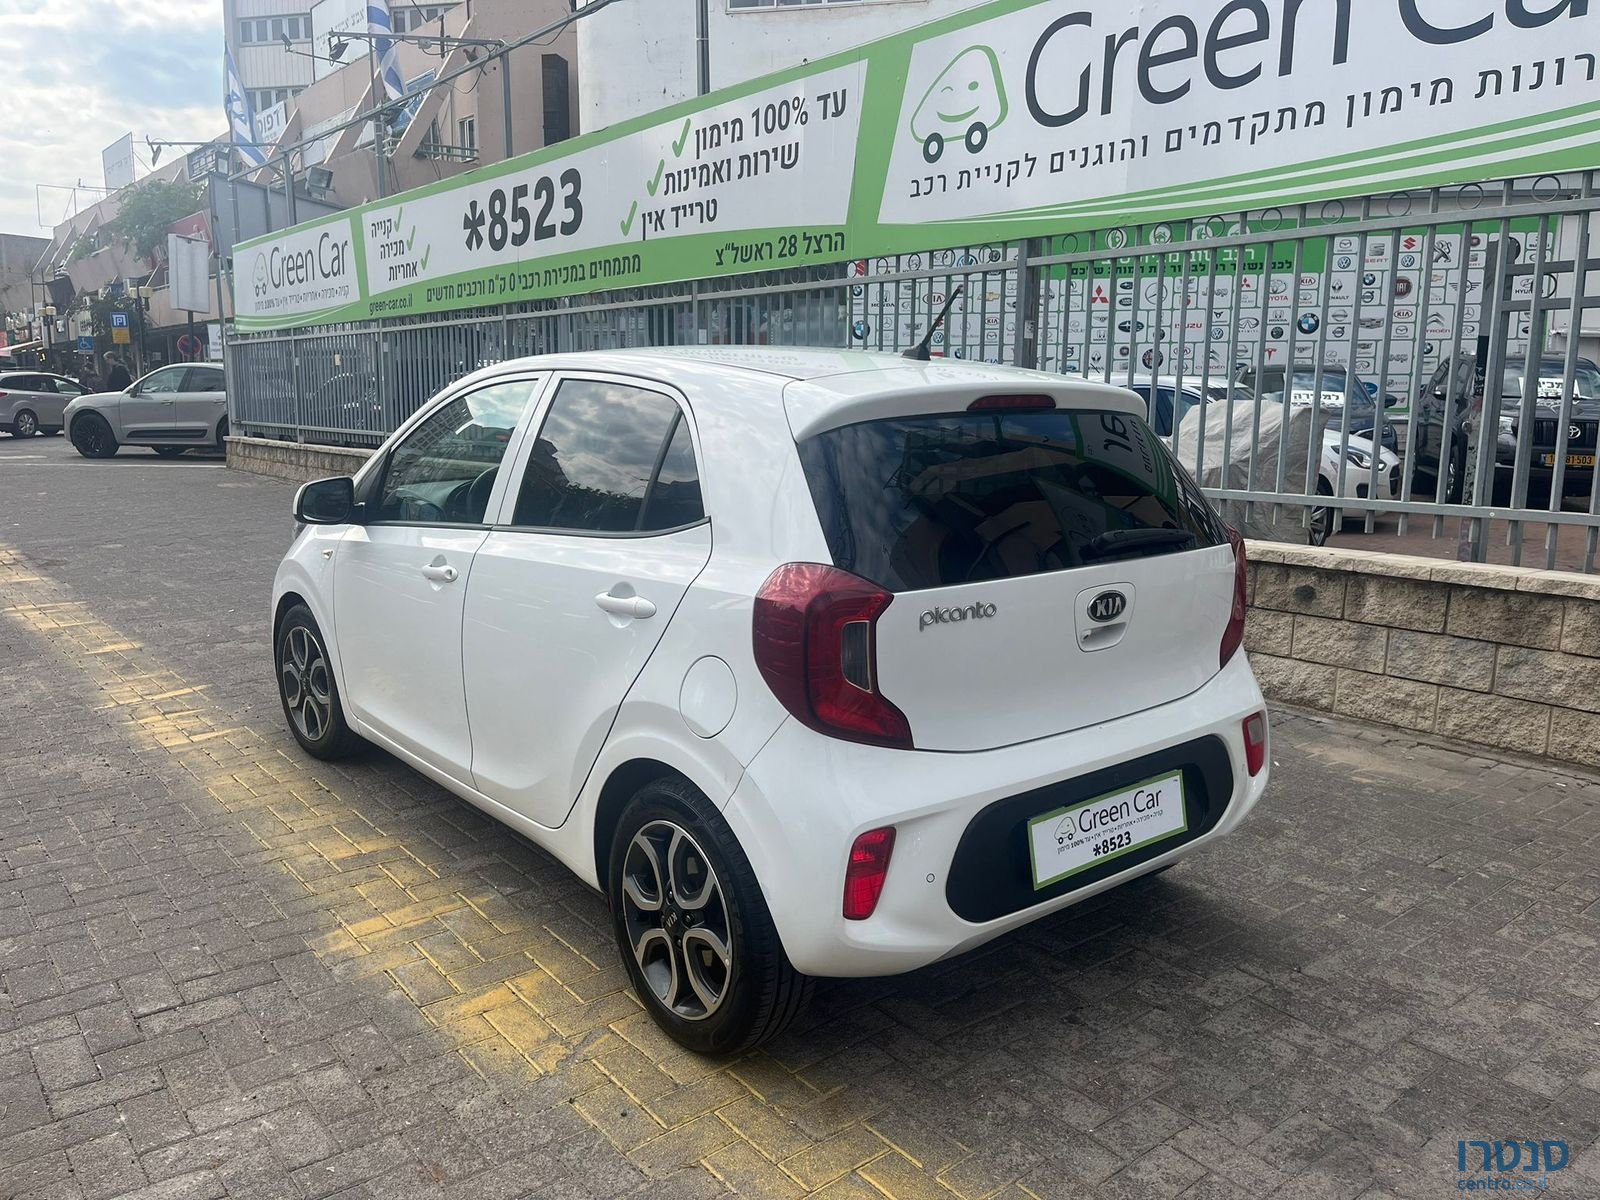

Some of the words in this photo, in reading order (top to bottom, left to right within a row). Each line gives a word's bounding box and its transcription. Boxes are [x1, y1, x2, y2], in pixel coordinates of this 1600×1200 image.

[817, 88, 847, 120] עד
[1346, 76, 1453, 128] מימון
[751, 96, 809, 137] 100%
[1164, 101, 1326, 153] מתקדמים
[695, 118, 744, 159] מימון
[737, 142, 799, 180] שירות
[1050, 135, 1149, 173] והוגנים
[664, 158, 732, 196] ואמינות
[957, 152, 1037, 188] לקניית
[910, 174, 947, 198] רכב
[641, 209, 665, 241] אין
[671, 198, 718, 227] טרייד
[371, 218, 393, 239] קנייה
[380, 239, 405, 260] מכירה
[778, 234, 798, 258] 28
[802, 231, 844, 256] הרצל
[270, 246, 315, 288] Green
[319, 232, 348, 279] Car
[388, 260, 418, 282] אחריות
[589, 254, 641, 279] מתמחים
[509, 273, 516, 292] 0
[518, 272, 541, 291] רכבי
[543, 264, 586, 286] במכירת
[426, 284, 455, 303] חדשים
[457, 280, 486, 299] ורכבים
[369, 292, 413, 316] green-car.co.il
[919, 601, 997, 632] picanto
[1096, 597, 1123, 617] KIA
[1079, 802, 1130, 833] Green
[1134, 790, 1162, 813] Car
